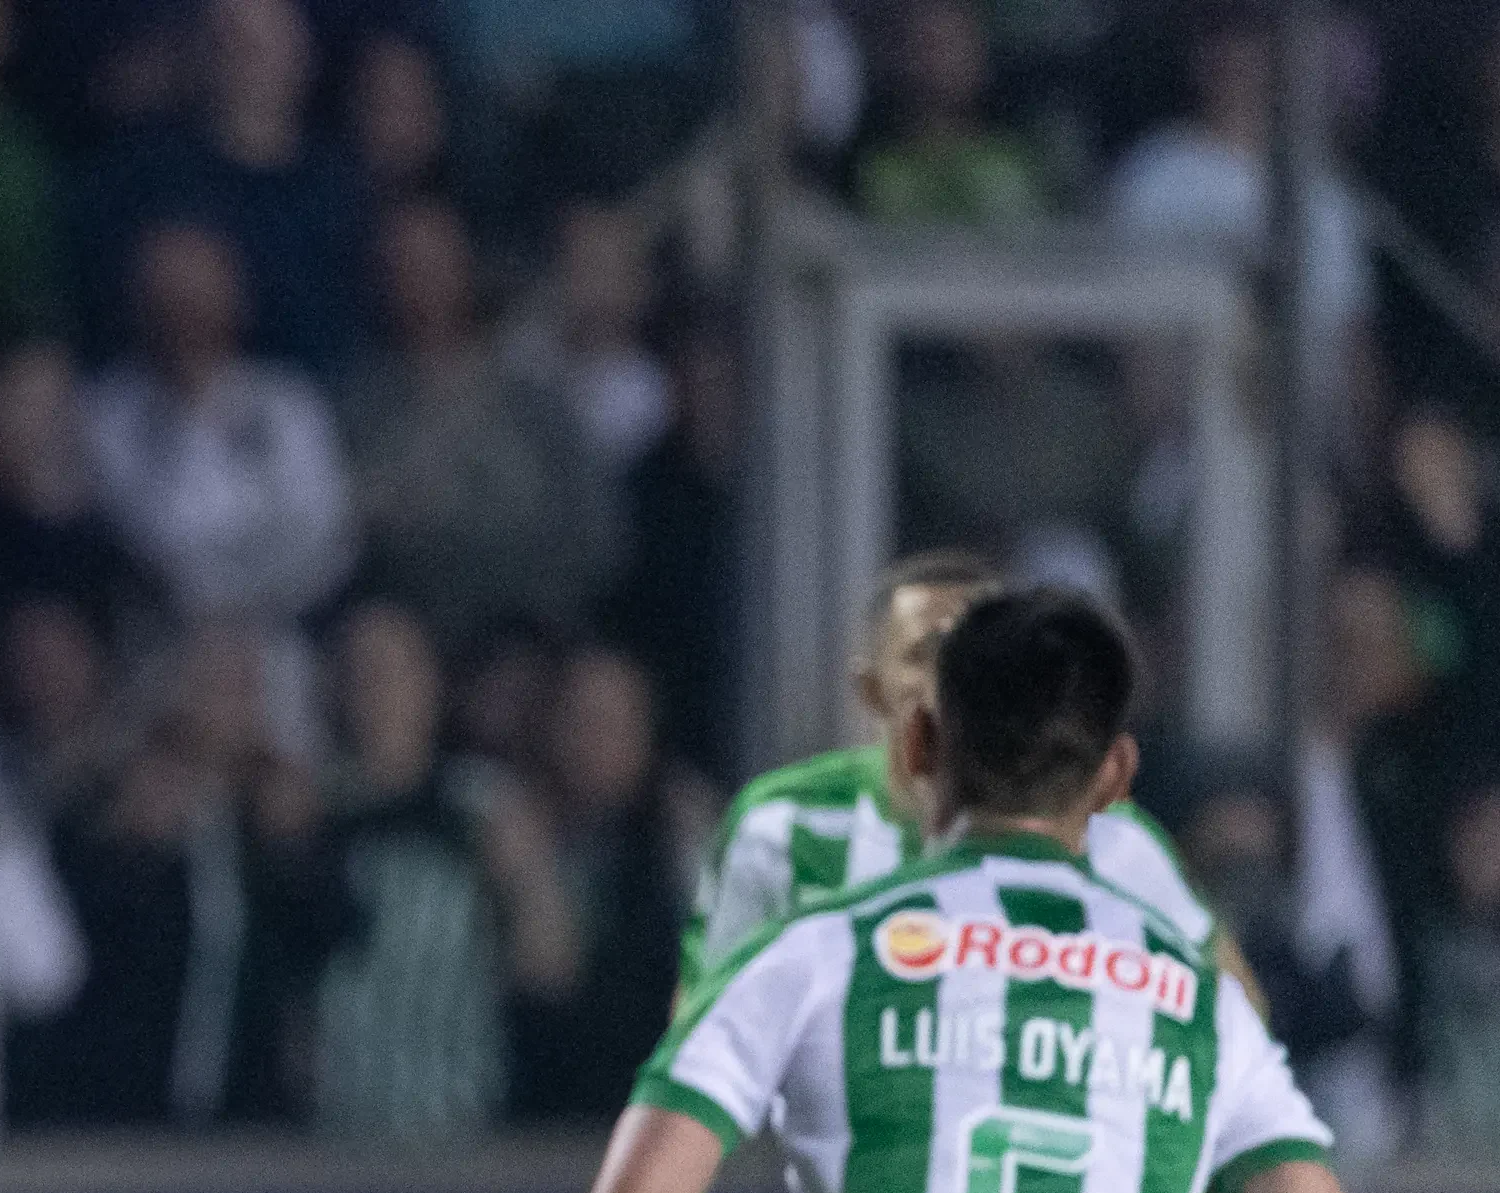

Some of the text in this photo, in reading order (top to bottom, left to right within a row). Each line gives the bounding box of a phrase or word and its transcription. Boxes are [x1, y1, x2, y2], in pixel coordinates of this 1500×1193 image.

[955, 922, 1189, 1008] RodOil
[881, 1004, 1193, 1122] LUIS OYAMA
